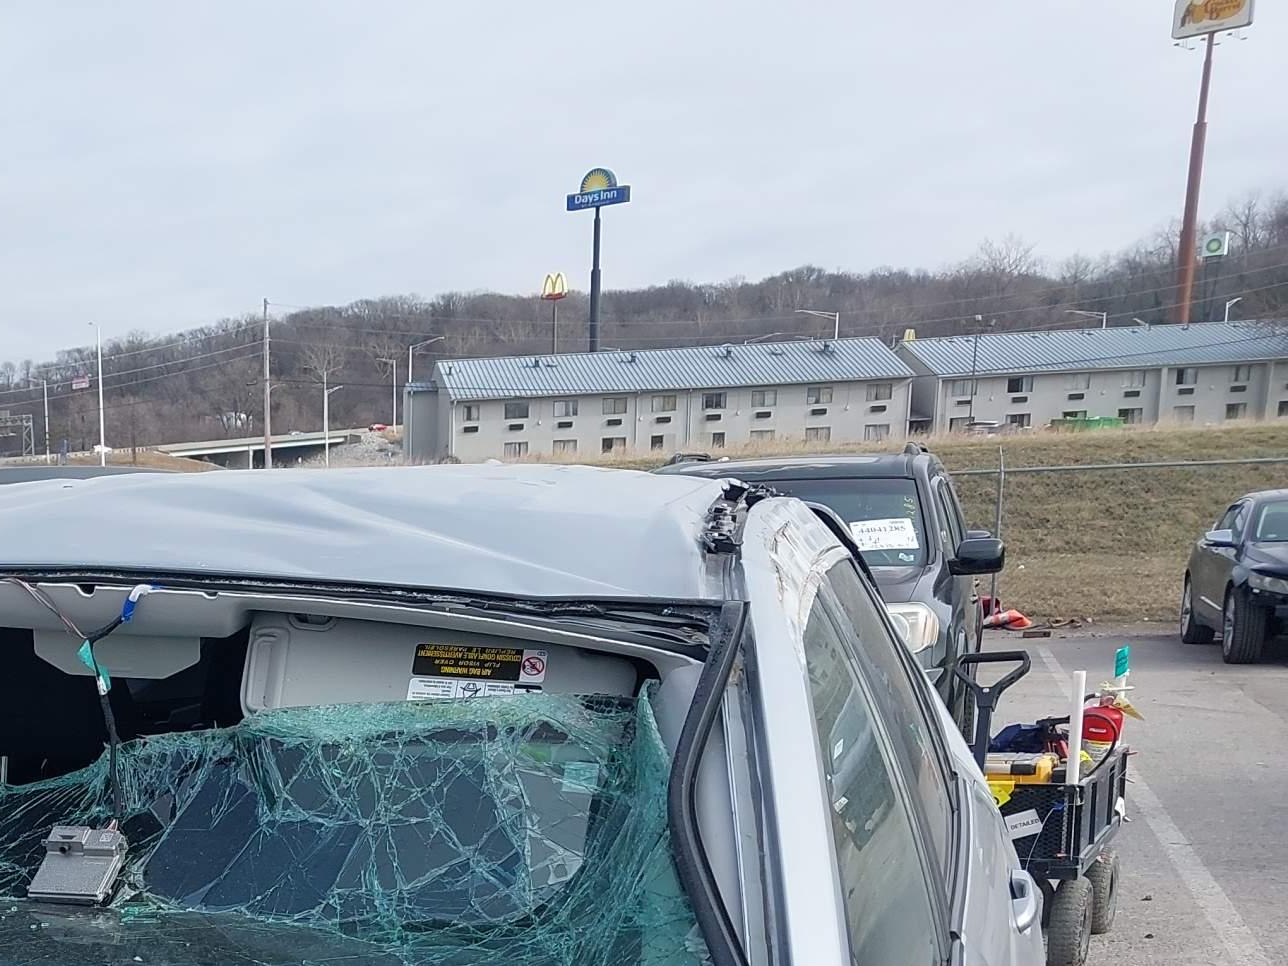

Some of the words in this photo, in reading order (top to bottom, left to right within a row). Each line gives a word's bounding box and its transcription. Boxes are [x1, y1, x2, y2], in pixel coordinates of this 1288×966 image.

[574, 193, 600, 204] Days
[600, 190, 617, 200] Inn
[1010, 819, 1040, 830] DETAILED
